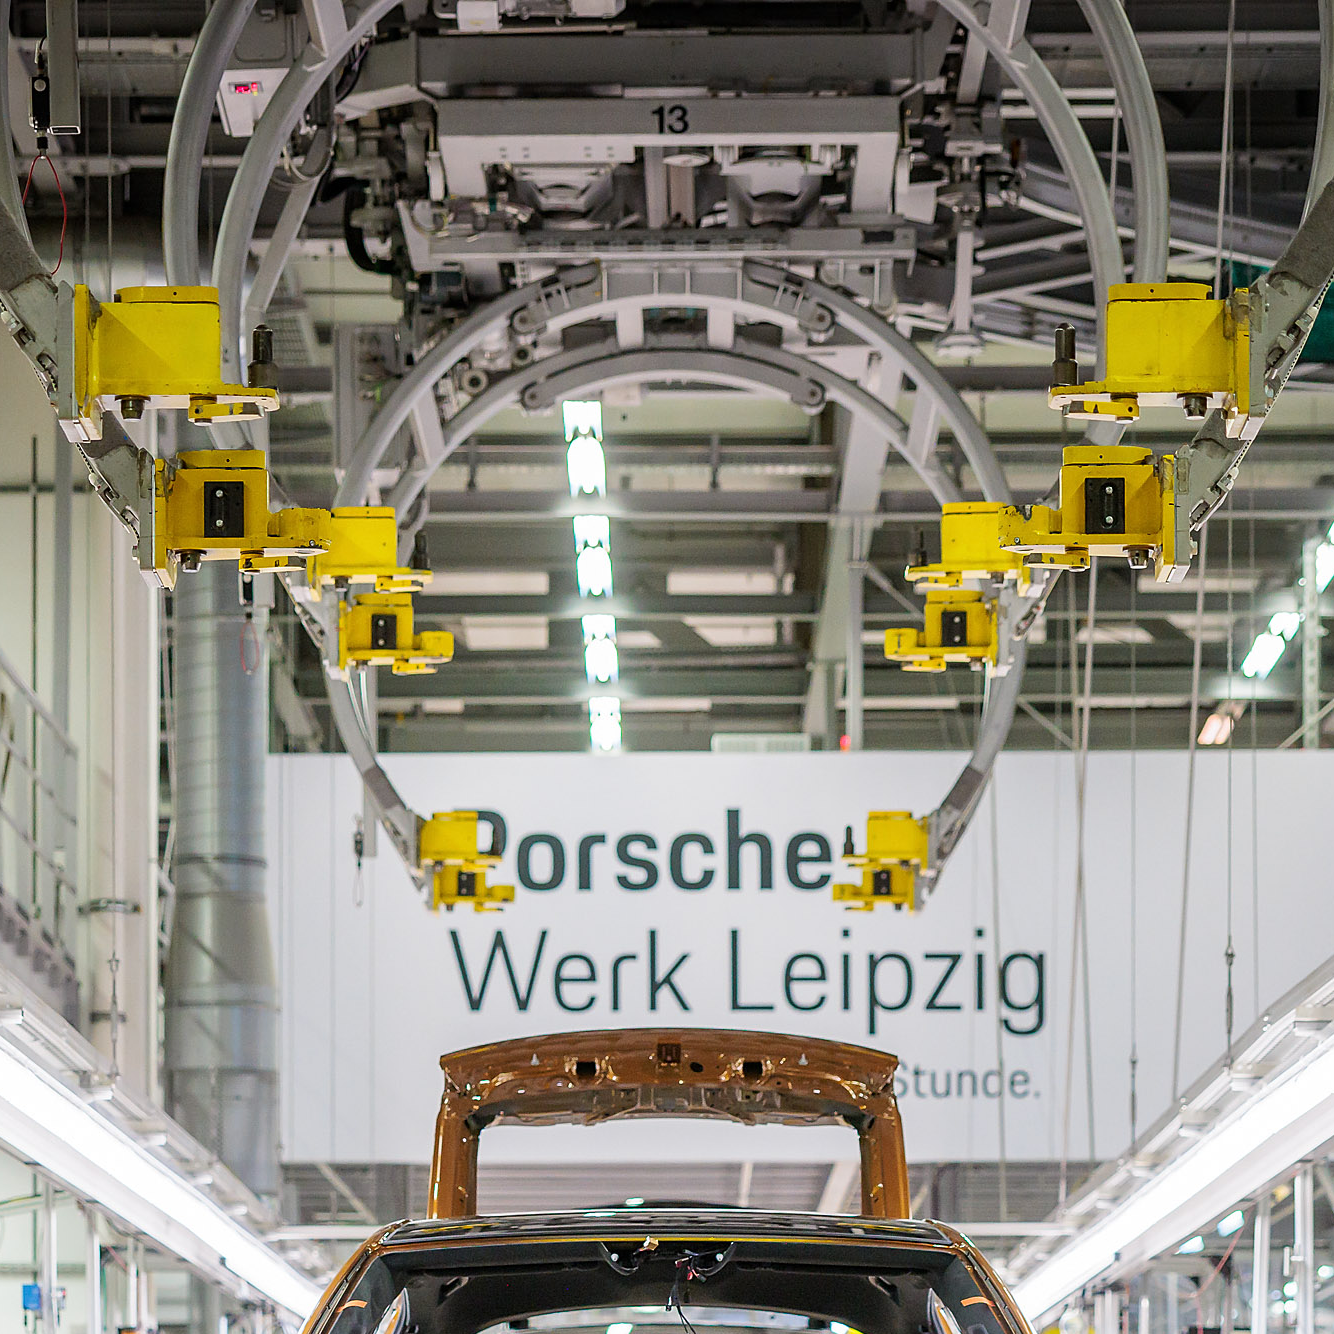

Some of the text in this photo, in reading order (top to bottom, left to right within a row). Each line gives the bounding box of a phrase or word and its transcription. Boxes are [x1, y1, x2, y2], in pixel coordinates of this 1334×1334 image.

[652, 104, 689, 134] 13
[449, 927, 1046, 1035] Werk Leipzig
[896, 1060, 1041, 1099] Stunde.
